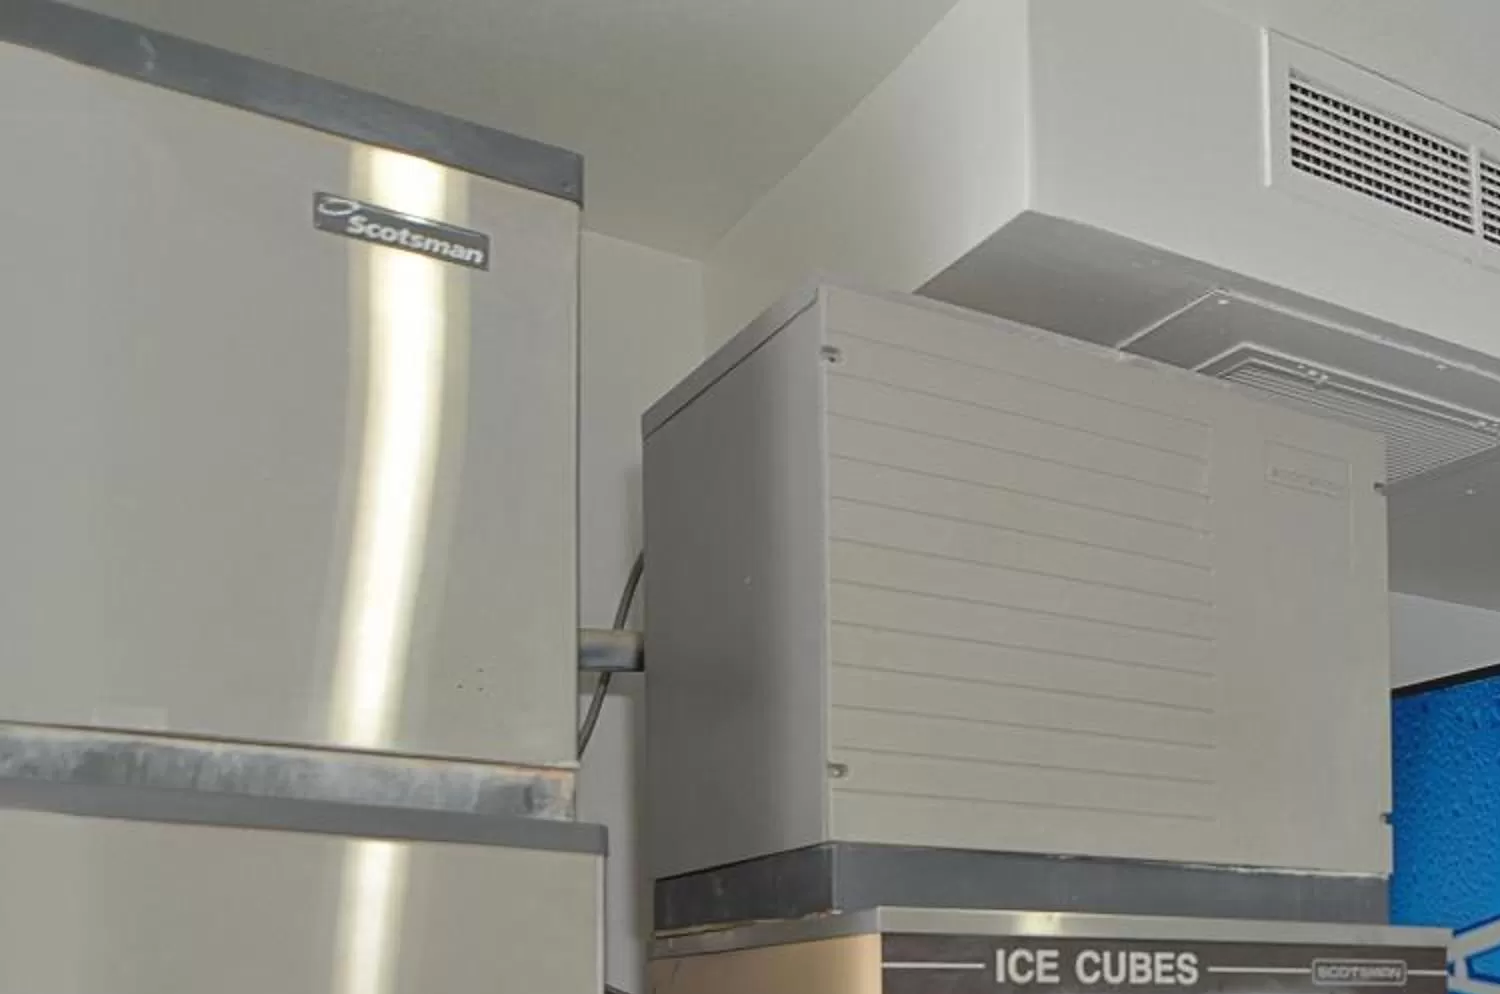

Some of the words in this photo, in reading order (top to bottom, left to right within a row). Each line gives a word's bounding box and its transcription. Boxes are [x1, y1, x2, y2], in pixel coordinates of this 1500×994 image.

[346, 215, 484, 264] Scotsman
[996, 948, 1060, 984] ICE
[1075, 949, 1199, 985] CUBES
